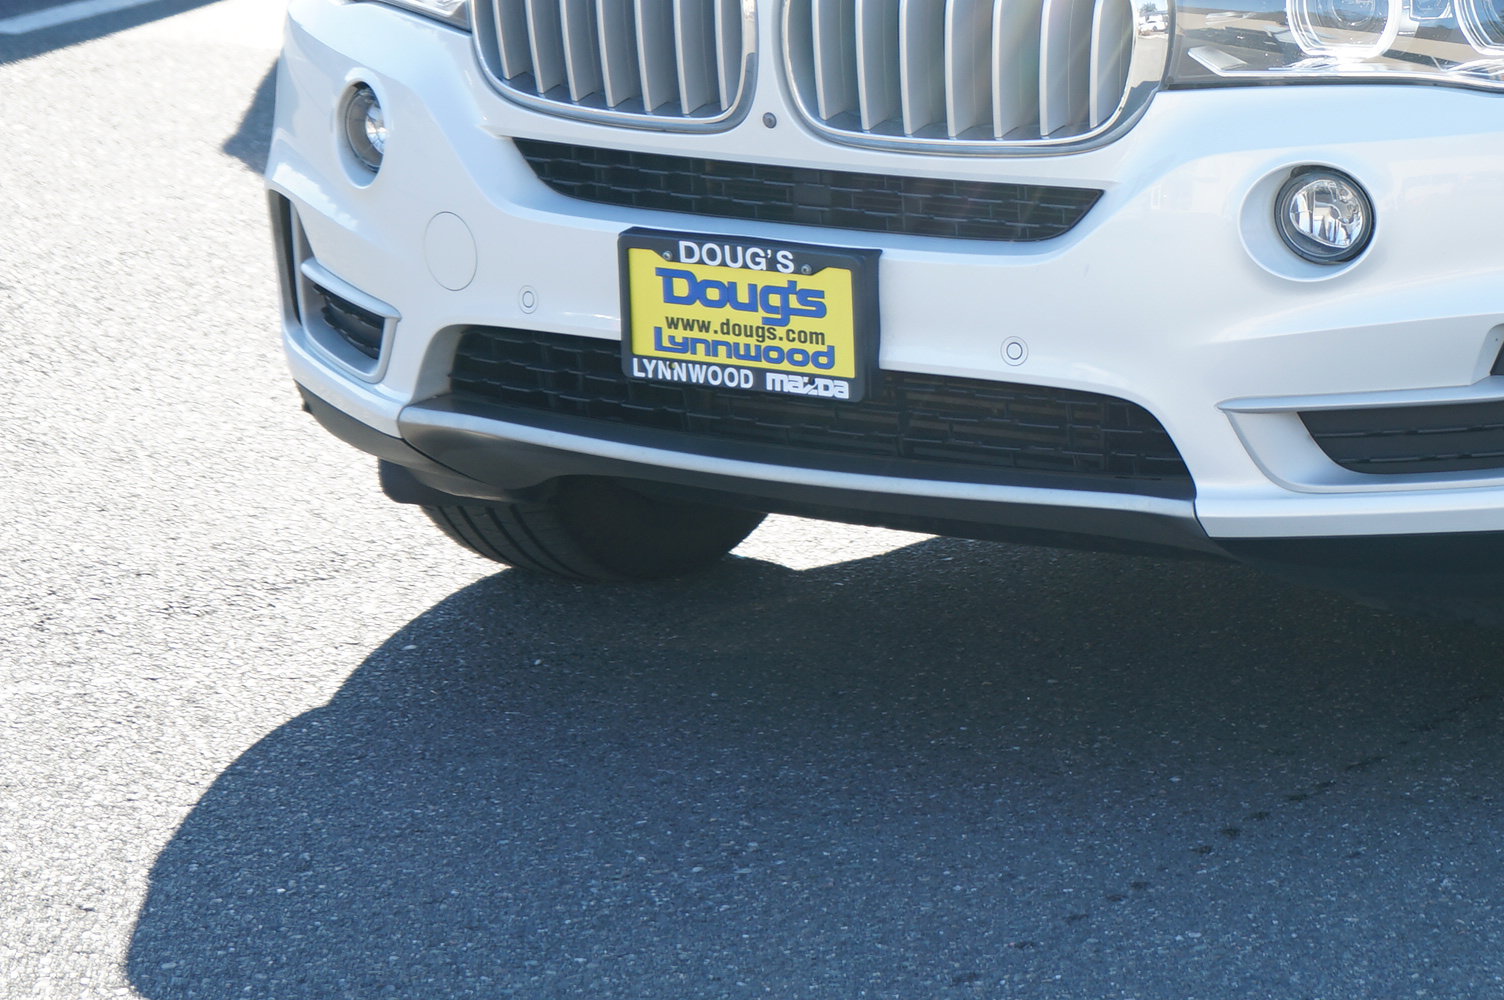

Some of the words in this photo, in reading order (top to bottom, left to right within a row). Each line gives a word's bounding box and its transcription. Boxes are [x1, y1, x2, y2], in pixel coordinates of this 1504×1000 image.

[678, 240, 795, 274] DOUG'S
[665, 316, 826, 346] www.dougs.com
[654, 326, 836, 370] Lynnwood
[633, 357, 754, 389] LYNNWOOD
